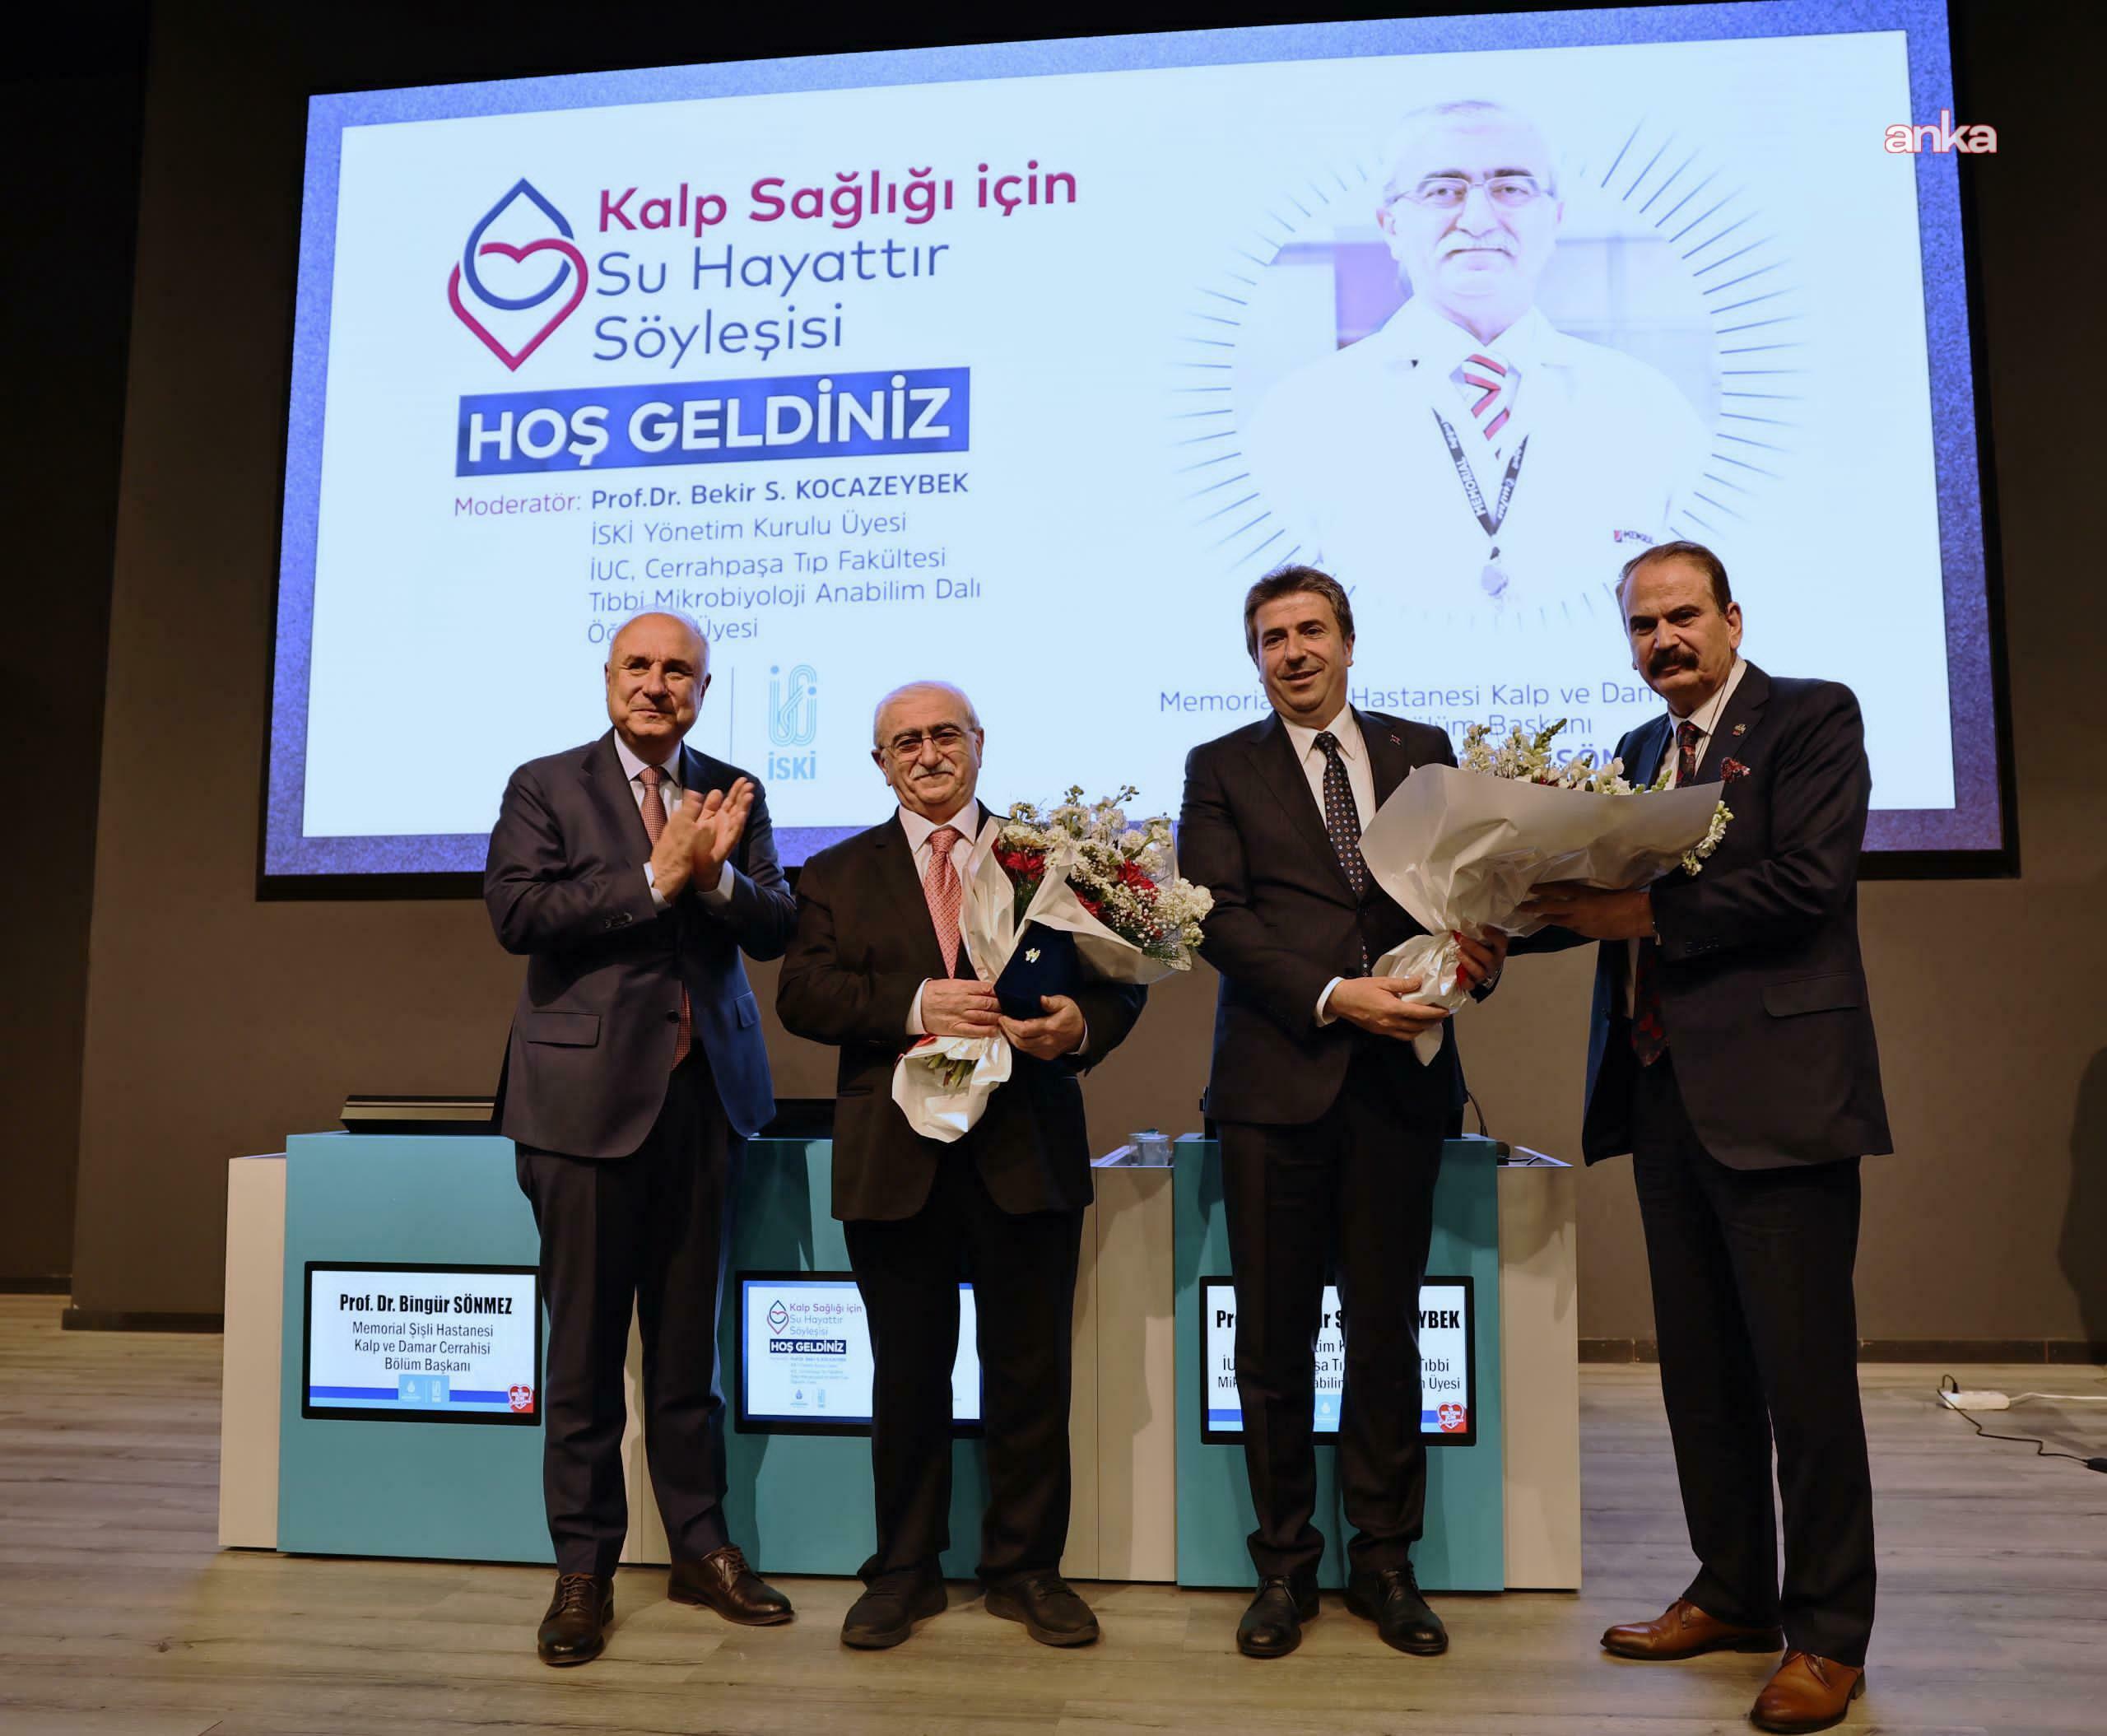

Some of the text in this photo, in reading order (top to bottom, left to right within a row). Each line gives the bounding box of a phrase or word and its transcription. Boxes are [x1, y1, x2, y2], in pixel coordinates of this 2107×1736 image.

[599, 160, 1076, 238] Kalp Sağlığı için
[596, 237, 949, 297] Su Hayattır
[593, 303, 842, 369] Söyleşisi
[470, 374, 951, 465] HOŞ GELDİNİZ
[455, 472, 968, 516] Moderatör: Prof.Dr. Bekir S. KOCAZEYBEK
[593, 510, 905, 545] İSKİ Yönetim Kurulu Üyesi
[645, 556, 783, 579] Cerrahpaşa
[793, 552, 828, 574] Tıp
[840, 547, 945, 570] Fakültesi
[588, 578, 980, 612] Tıbbi Mikrobiyoloji Anabilim Dalı
[1160, 682, 1665, 711] Memoria Hastanesi Kalp ve Dam
[768, 751, 816, 781] İSKİ
[340, 1294, 512, 1315] Prof. Dr. Bingür SÖNMEZ
[789, 1303, 810, 1314] Kalp
[353, 1321, 493, 1338] Memorial Şişli Hastanesi
[356, 1339, 490, 1354] Kalp ve Damar Cerrahisi
[771, 1340, 844, 1353] HOŞ GELDİNİZ
[385, 1357, 470, 1371] Bölüm Başkanı
[1421, 1358, 1449, 1372] ıbbi
[1429, 1374, 1460, 1392] Üyesi
